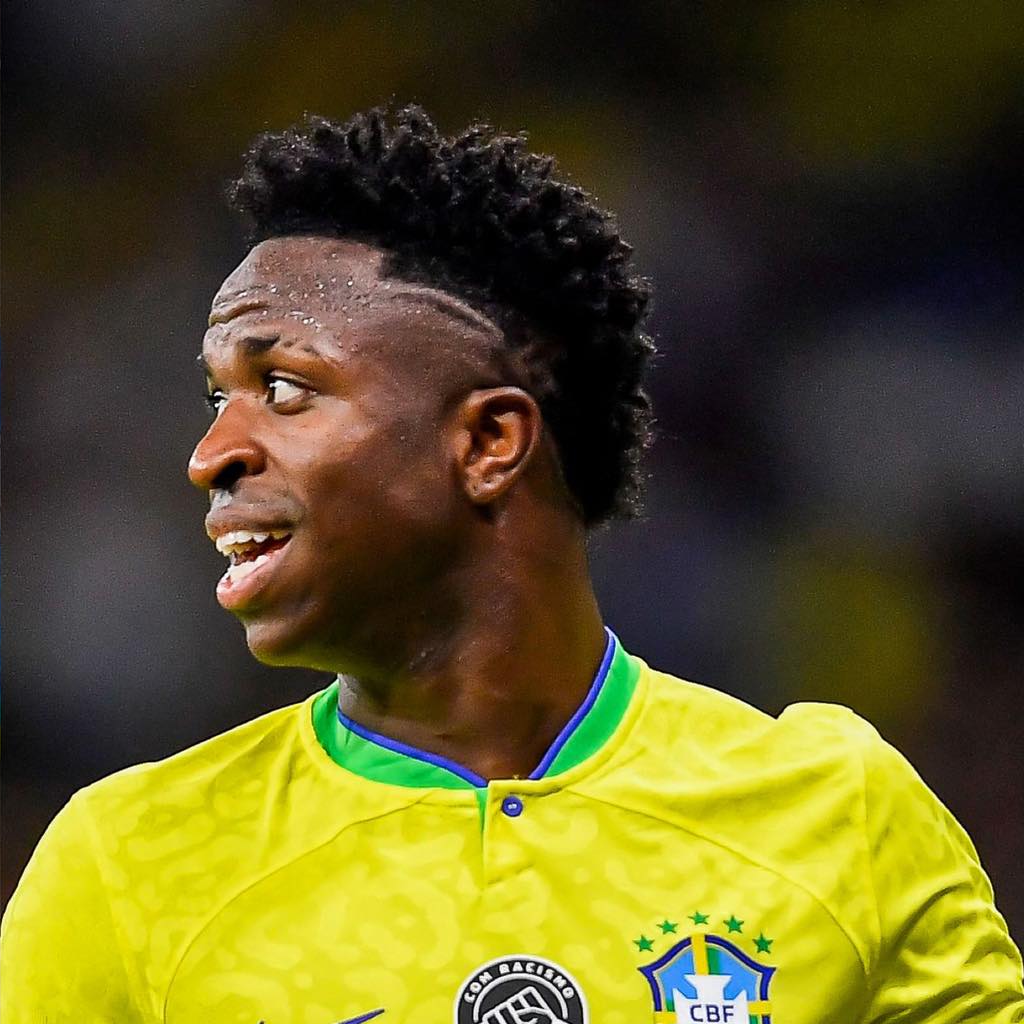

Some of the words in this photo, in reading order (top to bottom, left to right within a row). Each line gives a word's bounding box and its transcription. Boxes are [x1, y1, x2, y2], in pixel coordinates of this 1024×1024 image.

[464, 971, 493, 1003] COM
[498, 961, 575, 1000] RACISMO
[689, 1004, 734, 1023] CBF
